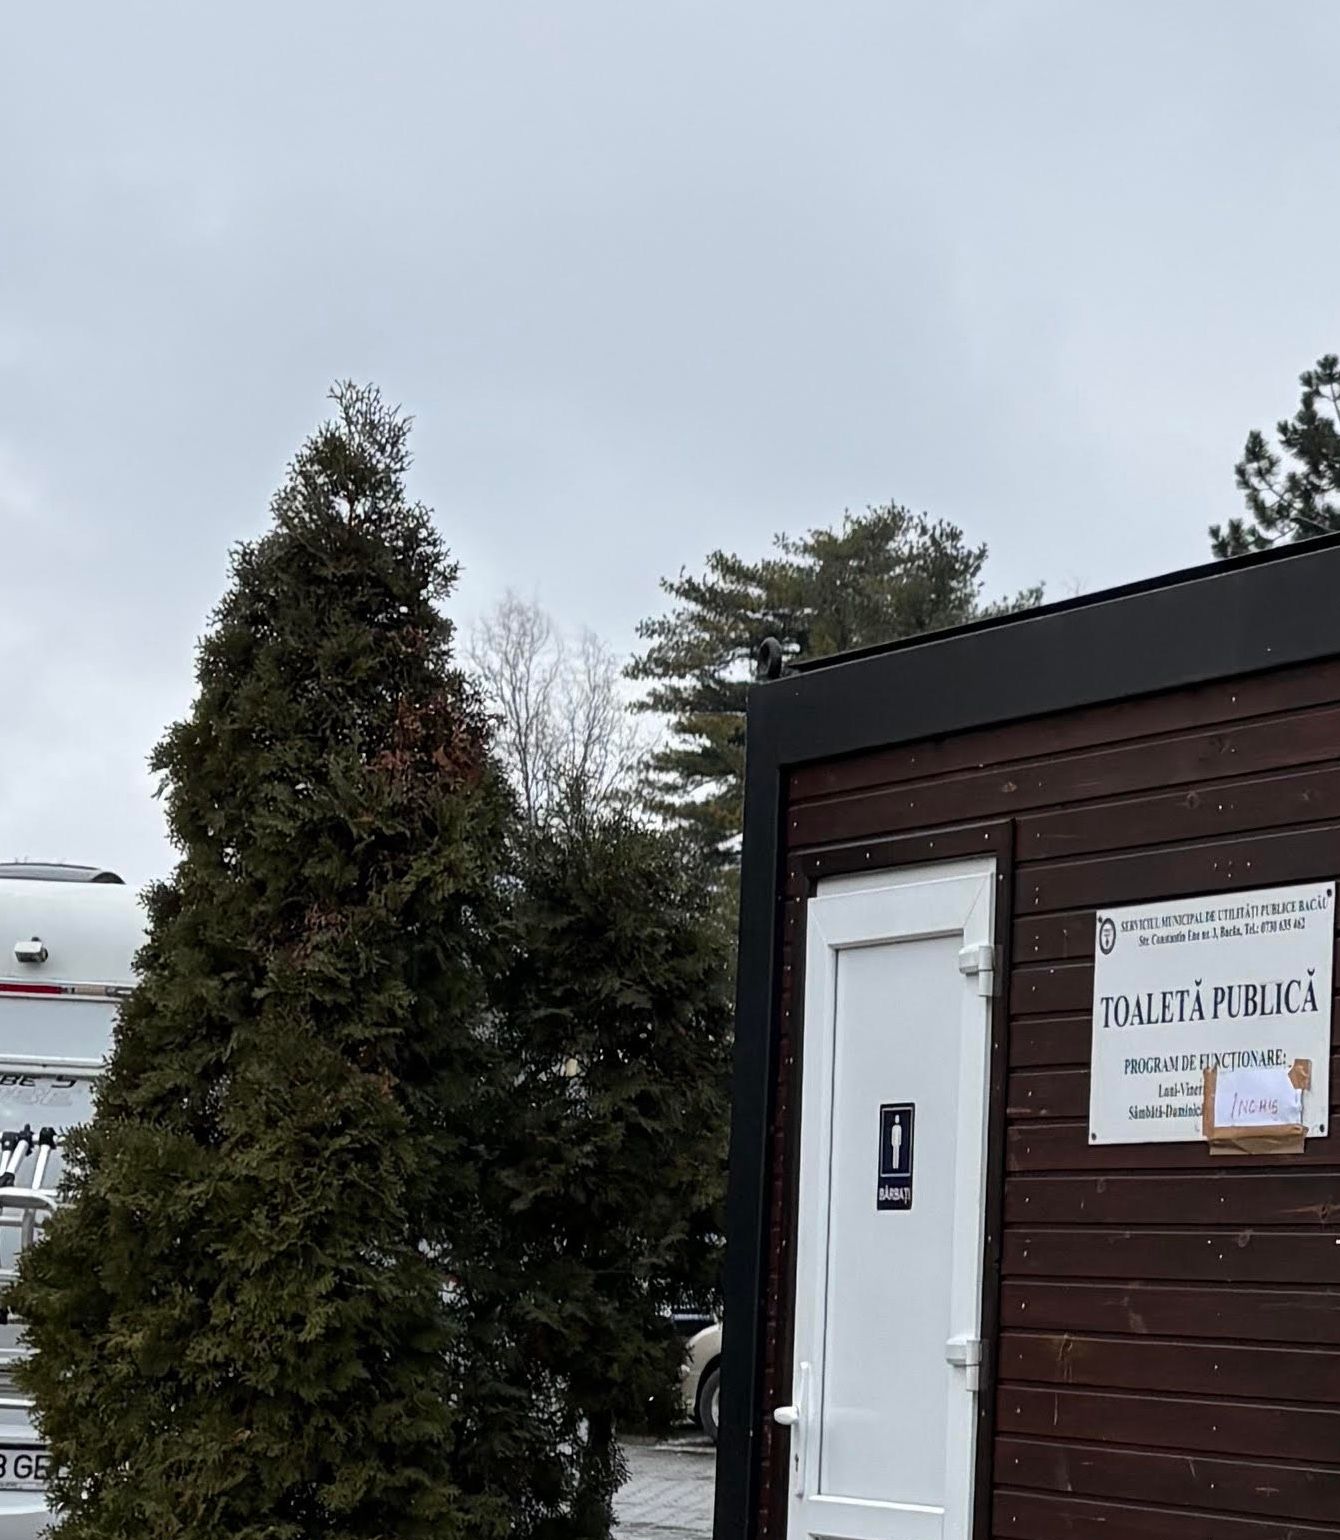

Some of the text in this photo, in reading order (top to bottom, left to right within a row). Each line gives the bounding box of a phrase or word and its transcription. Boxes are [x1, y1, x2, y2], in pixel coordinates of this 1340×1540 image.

[1161, 912, 1204, 927] MUNICIPAL
[1205, 910, 1216, 923] DE
[1260, 901, 1297, 917] PUBLICE
[1100, 968, 1319, 1029] TOALETĂ PUBLICĂ
[1124, 1055, 1179, 1075] PROGRAM
[1181, 1055, 1197, 1072] DE
